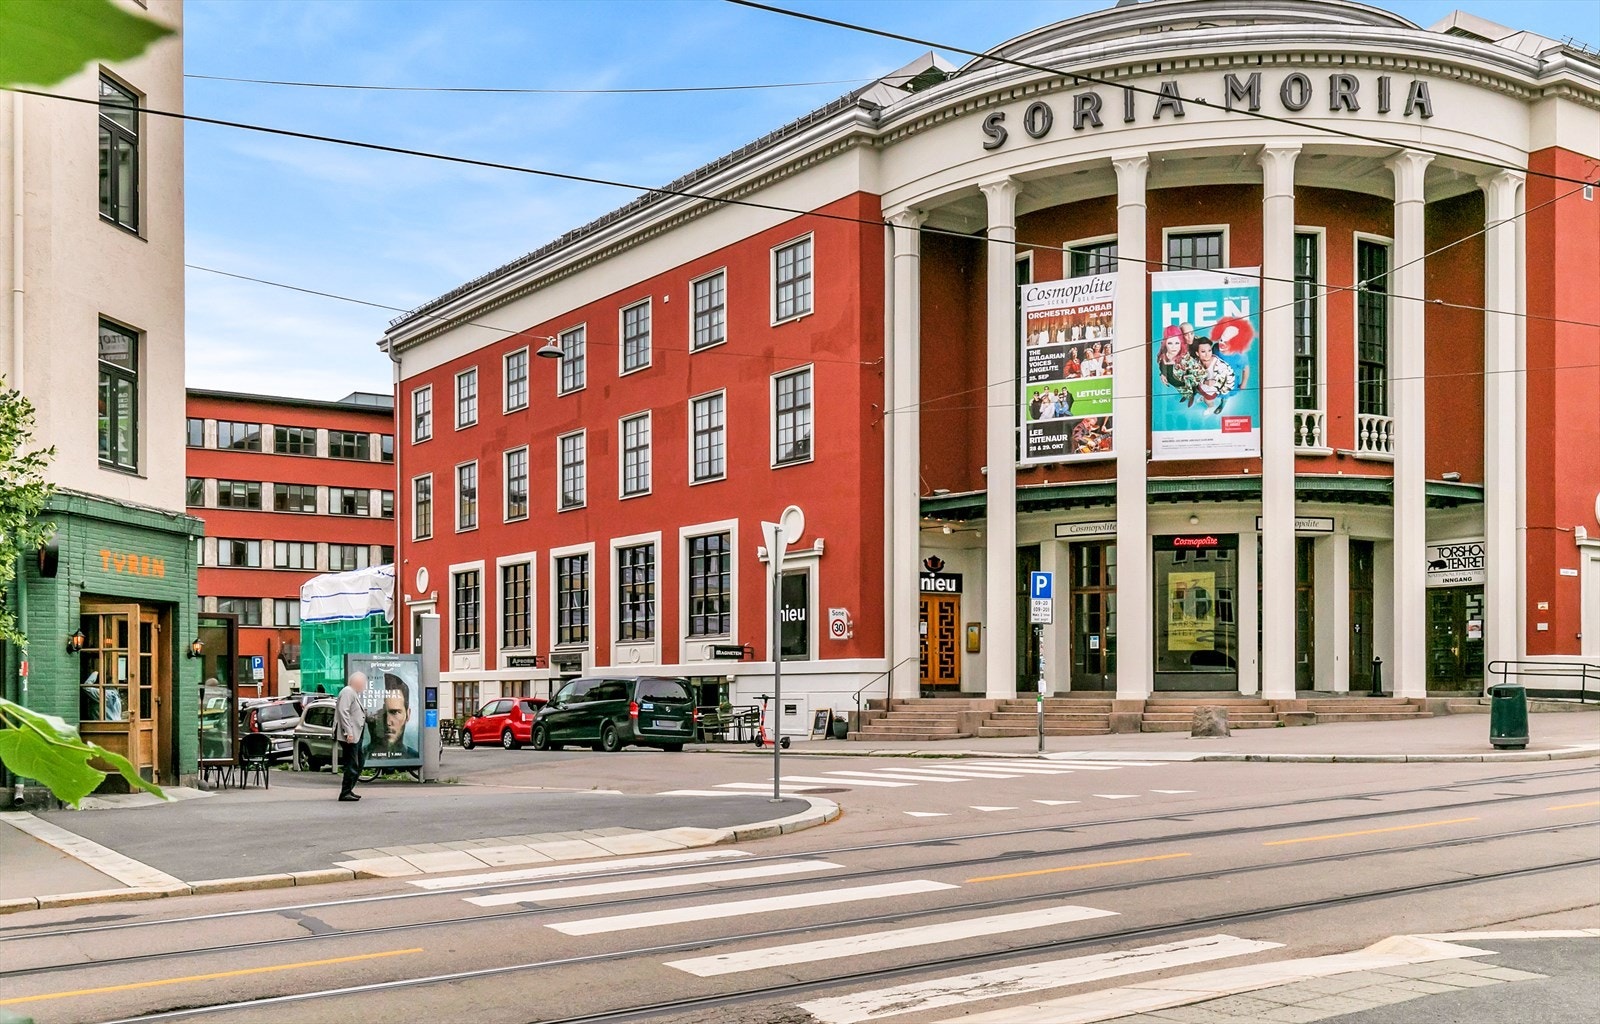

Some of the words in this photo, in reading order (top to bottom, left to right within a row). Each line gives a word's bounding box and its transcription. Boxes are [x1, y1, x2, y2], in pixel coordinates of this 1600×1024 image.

[982, 79, 1186, 150] SORIA
[1223, 71, 1434, 120] MORIA
[1026, 277, 1113, 302] Cosmopolite
[1028, 308, 1076, 320] ORCHESTRA
[1078, 303, 1112, 313] BAOBAB
[1162, 299, 1250, 328] HEN
[1028, 353, 1066, 362] BULGARIAN
[1028, 360, 1052, 368] VOICES
[1028, 365, 1059, 374] ANGELITE
[1076, 388, 1112, 398] LETTUCE
[1029, 434, 1068, 444] RITENAUR
[1069, 522, 1117, 533] Cosmopolite
[1173, 536, 1218, 548] Cosmopolite
[99, 549, 165, 579] TYREN
[1446, 556, 1484, 570] TEATRET
[920, 572, 956, 592] nieu
[1036, 575, 1048, 596] P
[834, 623, 844, 632] 30
[254, 657, 262, 668] P
